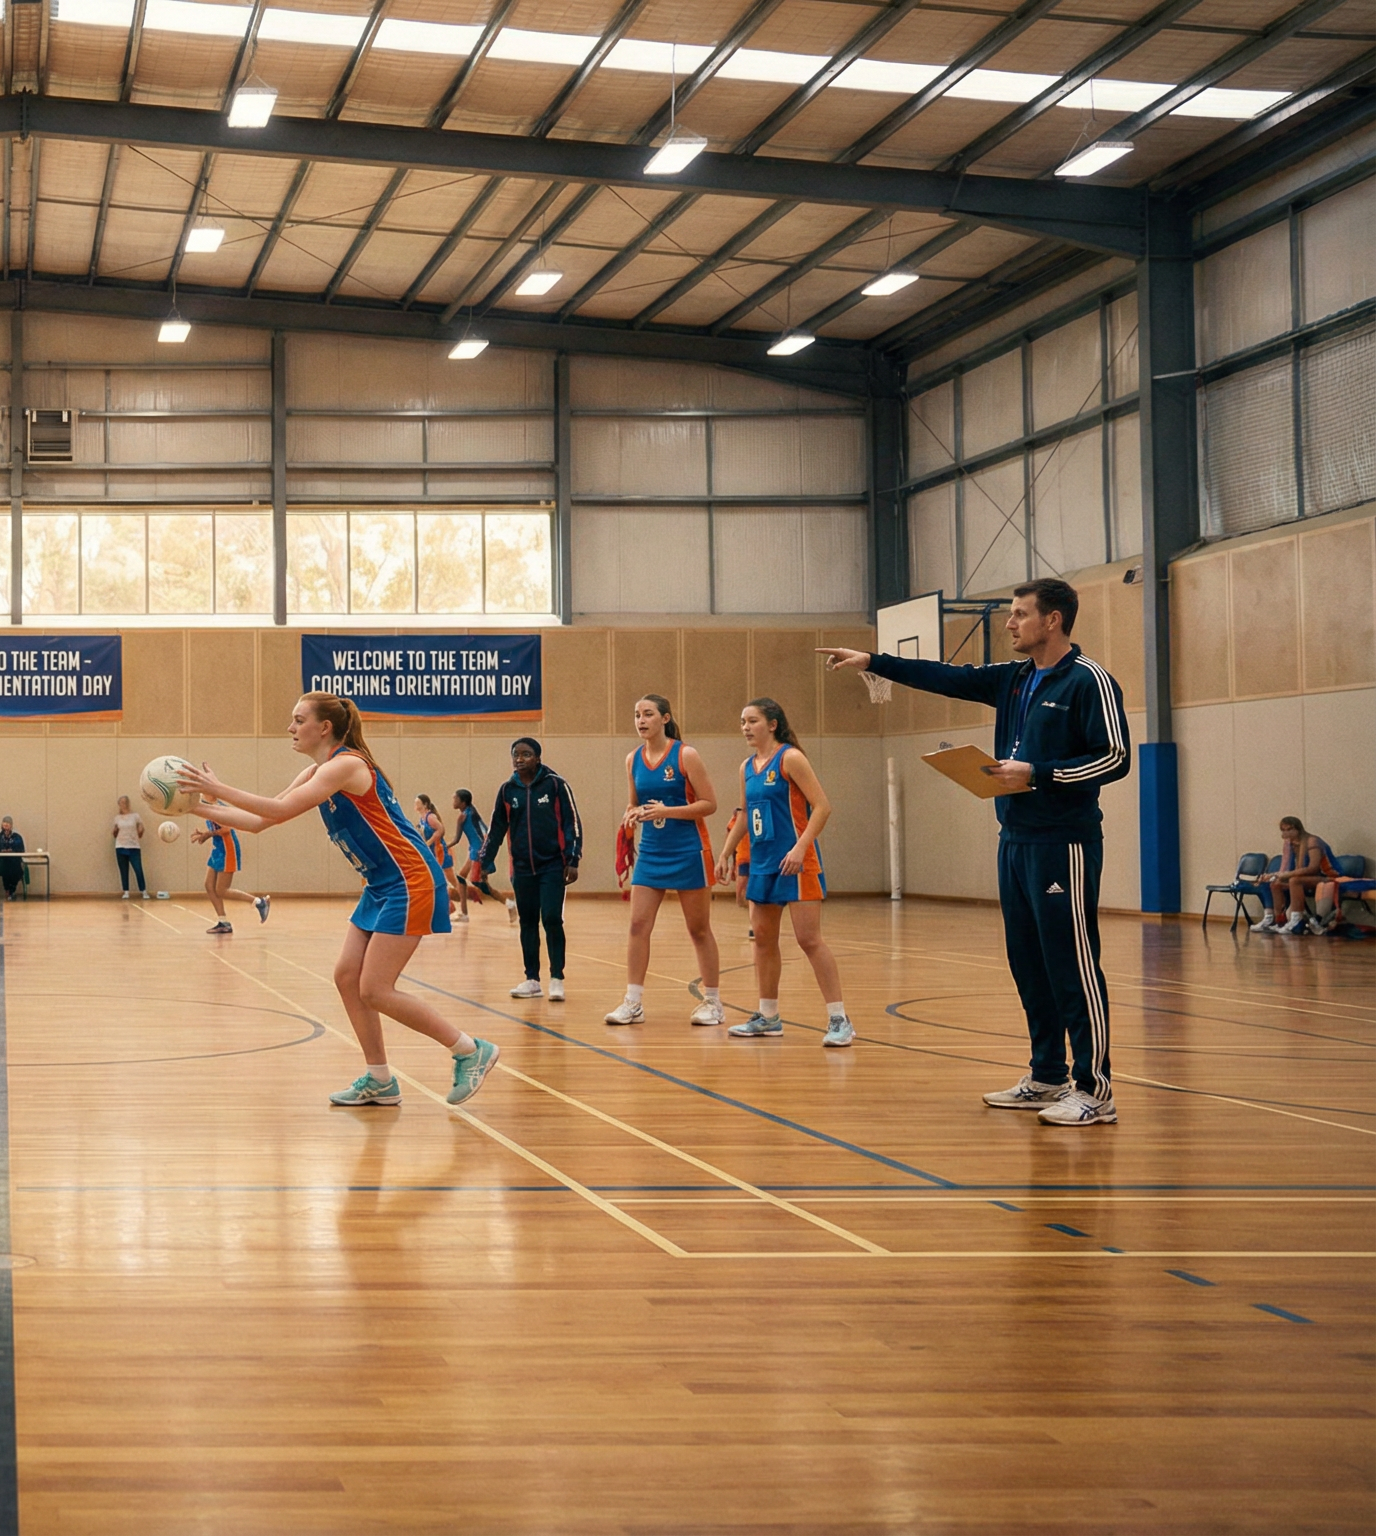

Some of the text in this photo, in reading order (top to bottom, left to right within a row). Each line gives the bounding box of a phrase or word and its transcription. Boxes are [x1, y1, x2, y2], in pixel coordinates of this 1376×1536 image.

[10, 651, 38, 671] THE
[41, 651, 80, 671] TEAM
[332, 650, 403, 671] WELCOME
[406, 650, 425, 671] TO
[429, 650, 456, 671] THE
[460, 650, 499, 671] TEAM
[82, 675, 112, 696] DAY
[311, 675, 531, 696] COACHING ORIENTATION DAY
